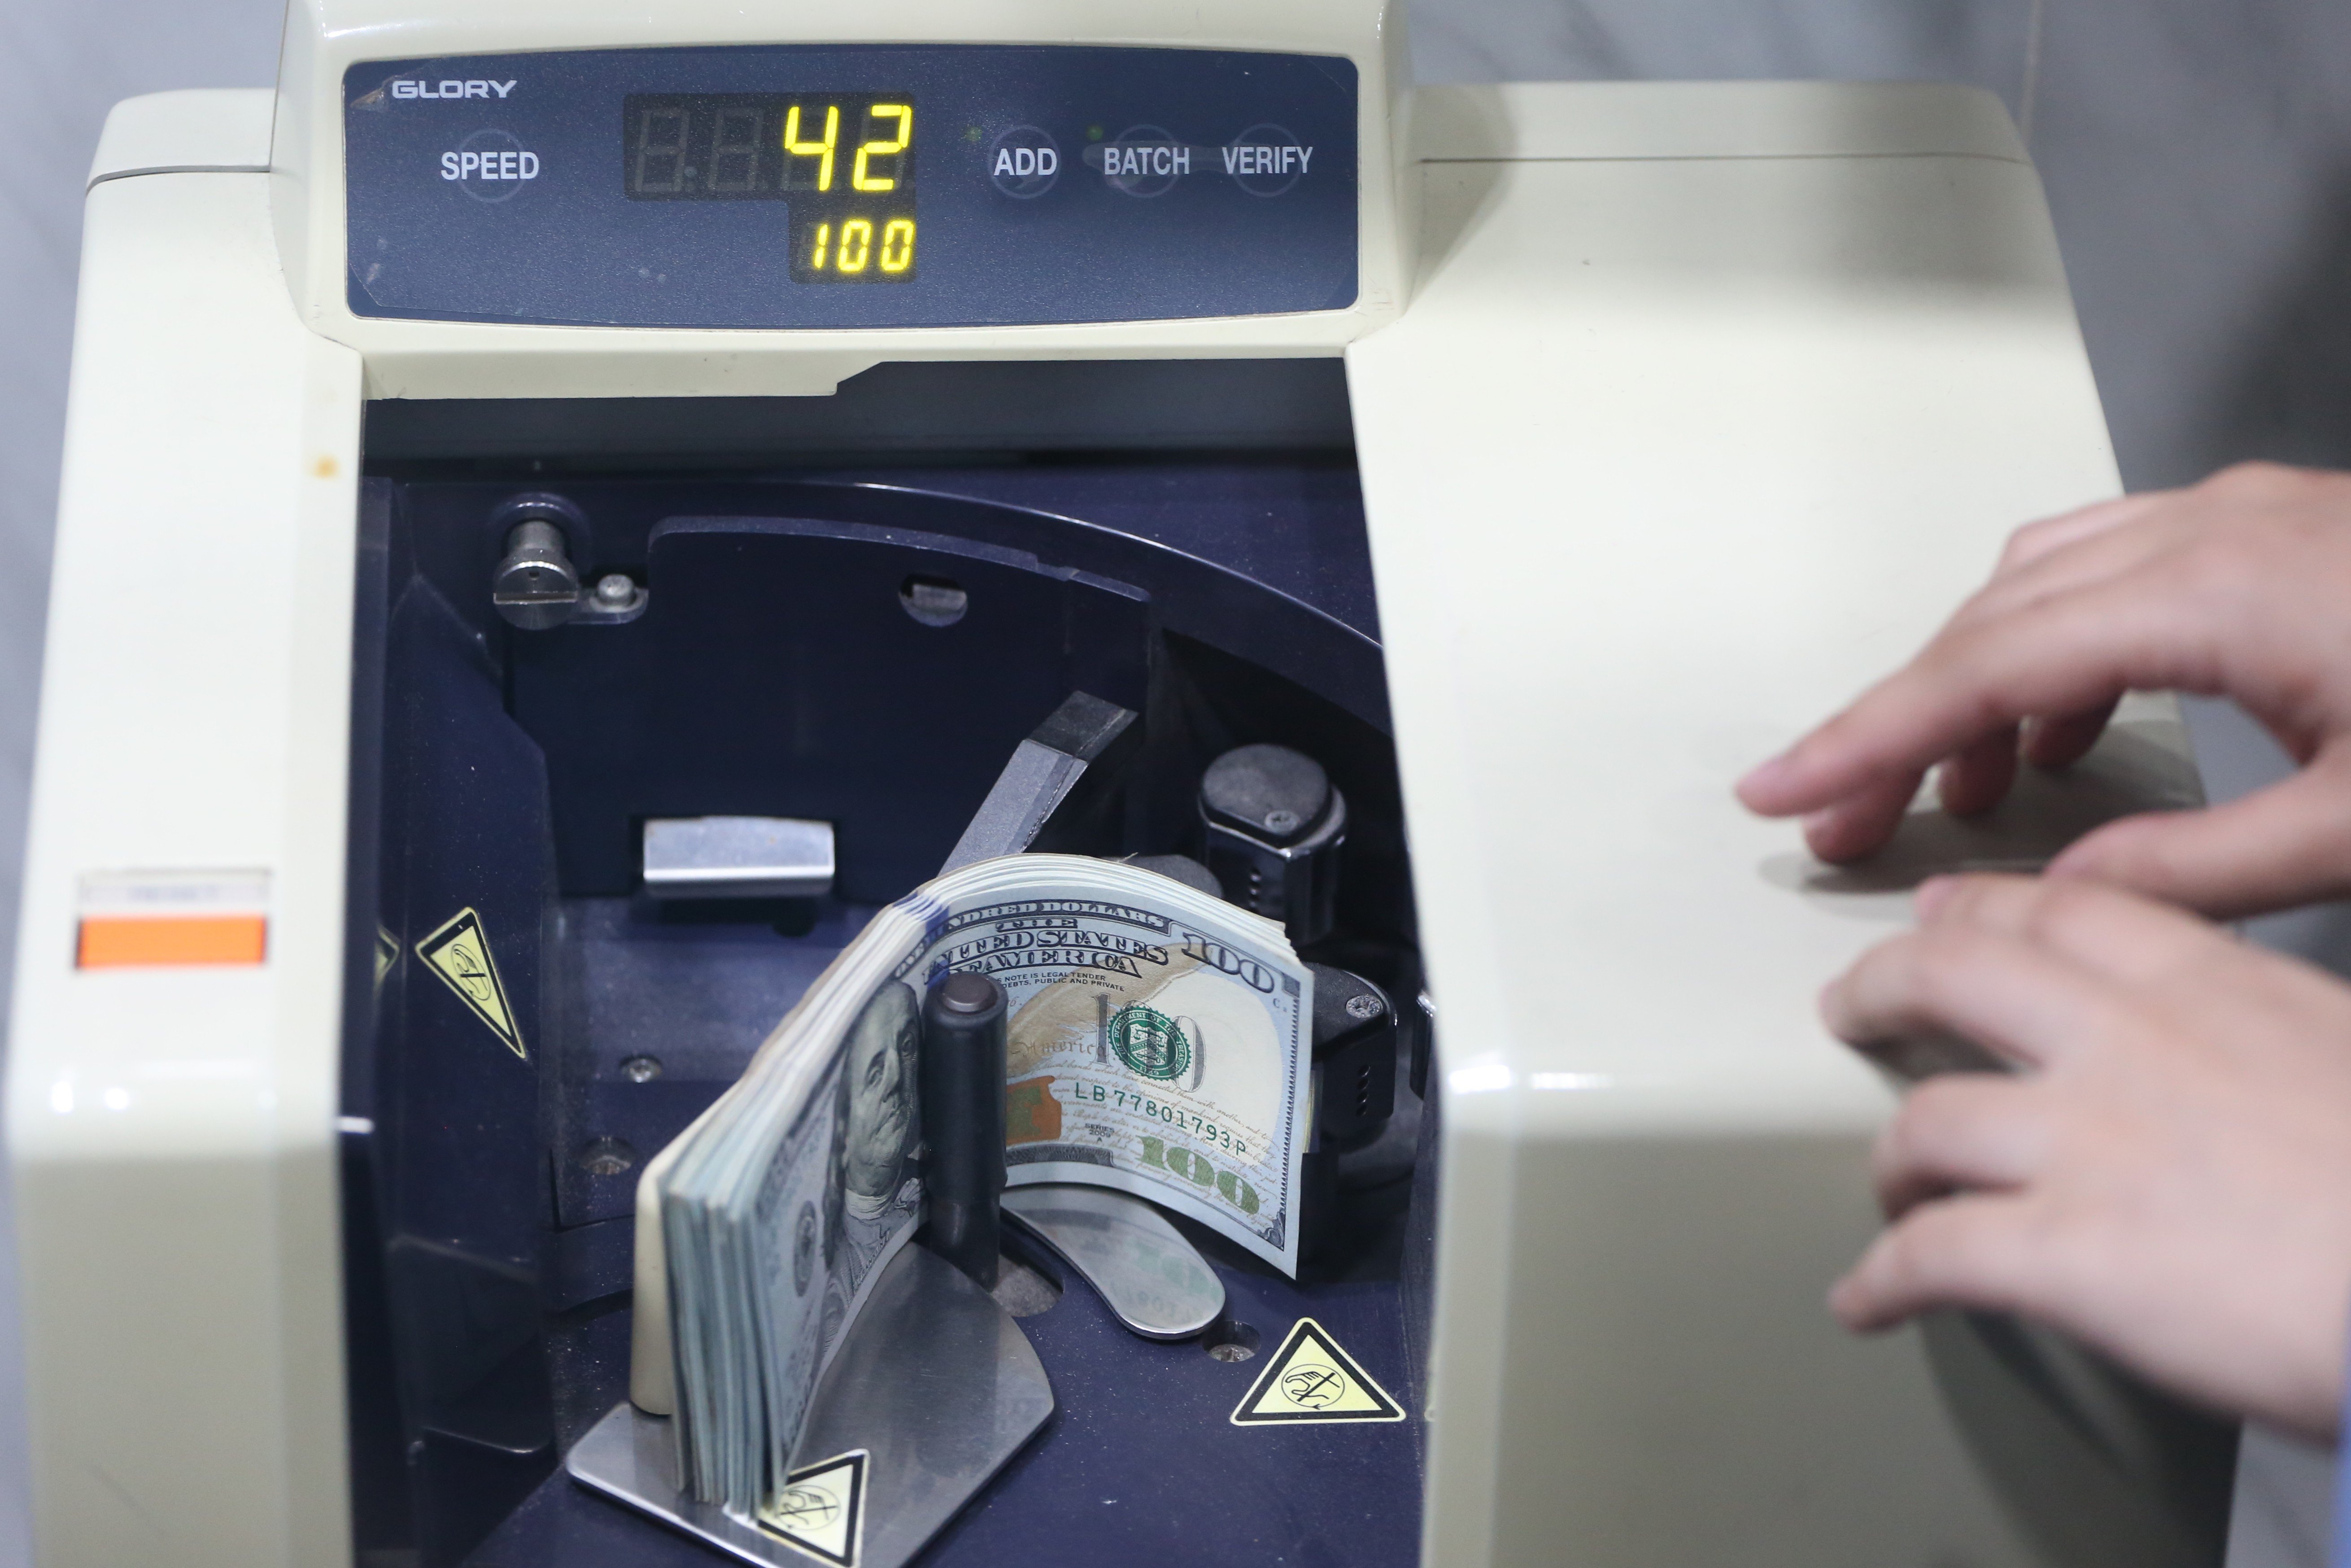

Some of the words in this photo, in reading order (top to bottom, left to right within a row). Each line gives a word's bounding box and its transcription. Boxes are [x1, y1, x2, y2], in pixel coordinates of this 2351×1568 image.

[392, 80, 517, 99] GLORY
[785, 105, 912, 192] 42
[994, 148, 1057, 175] ADD
[1104, 147, 1189, 175] BATCH
[1222, 147, 1312, 174] VERIFY
[441, 152, 539, 180] SPEED
[813, 220, 914, 272] 100
[995, 918, 1077, 932] THE
[1042, 902, 1164, 928] DOLLARS
[1036, 930, 1169, 966] STATES
[981, 949, 1143, 979] AMERICA
[1181, 932, 1274, 993] 100
[1005, 974, 1027, 982] NOTE
[1072, 972, 1106, 981] TENDER
[1091, 981, 1125, 992] PRIVATE
[1085, 1123, 1115, 1133] SERIES
[1181, 1106, 1220, 1123] mankind
[1089, 1129, 1111, 1138] 2009
[1135, 1135, 1260, 1215] 100
